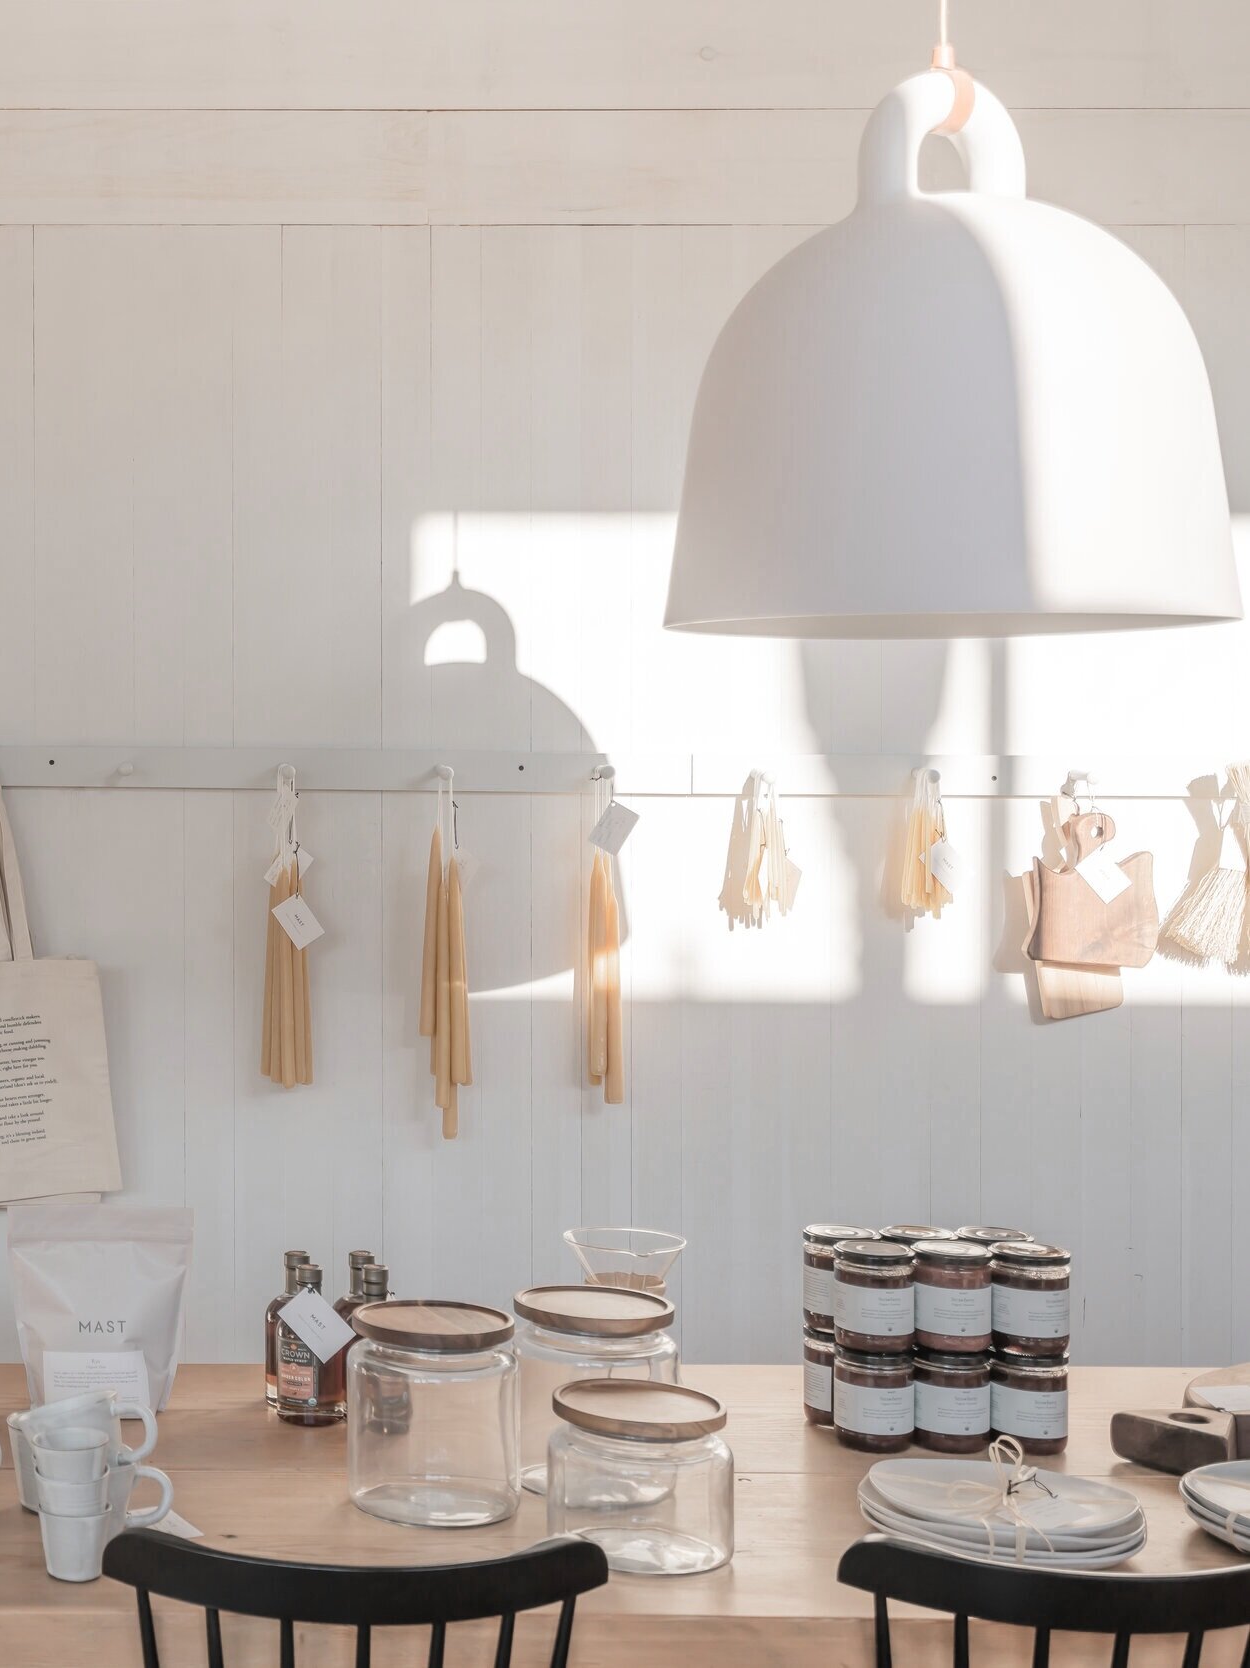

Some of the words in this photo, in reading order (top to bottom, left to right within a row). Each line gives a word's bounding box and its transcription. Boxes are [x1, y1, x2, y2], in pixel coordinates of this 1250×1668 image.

[78, 1320, 127, 1334] MAST
[310, 1314, 326, 1330] MAST
[281, 1349, 310, 1359] CROWN
